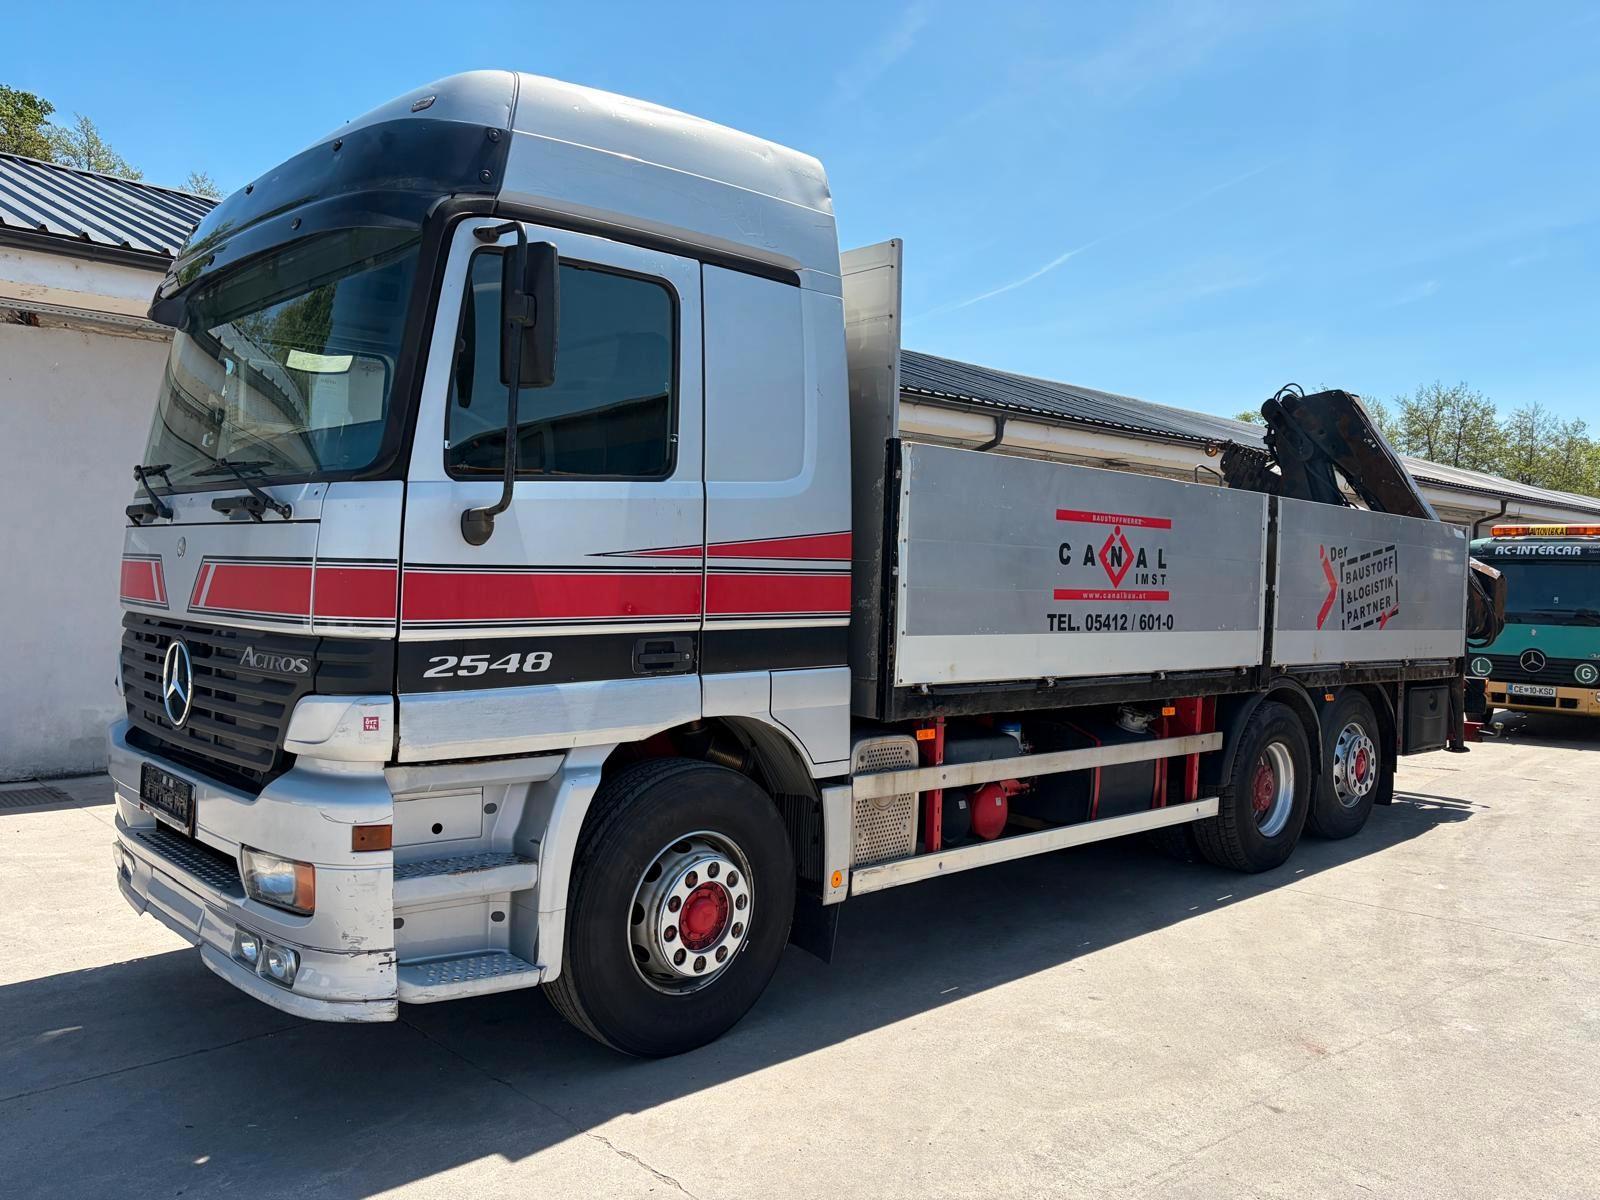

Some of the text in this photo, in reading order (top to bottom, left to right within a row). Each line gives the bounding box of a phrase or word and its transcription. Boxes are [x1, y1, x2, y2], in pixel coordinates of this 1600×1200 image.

[1058, 542, 1167, 569] CANAL
[1330, 546, 1348, 562] Der
[1494, 545, 1582, 555] AC-INTERCAR
[1345, 555, 1394, 585] BAUSTOFF
[1135, 573, 1167, 585] IMST
[1347, 595, 1392, 625] PARTNER
[1046, 613, 1081, 632] TEL.
[1085, 613, 1128, 632] 05412
[1139, 613, 1174, 631] 601-0
[422, 651, 553, 678] 2548
[1477, 661, 1486, 673] L
[1581, 668, 1592, 680] G
[1513, 685, 1524, 694] CE
